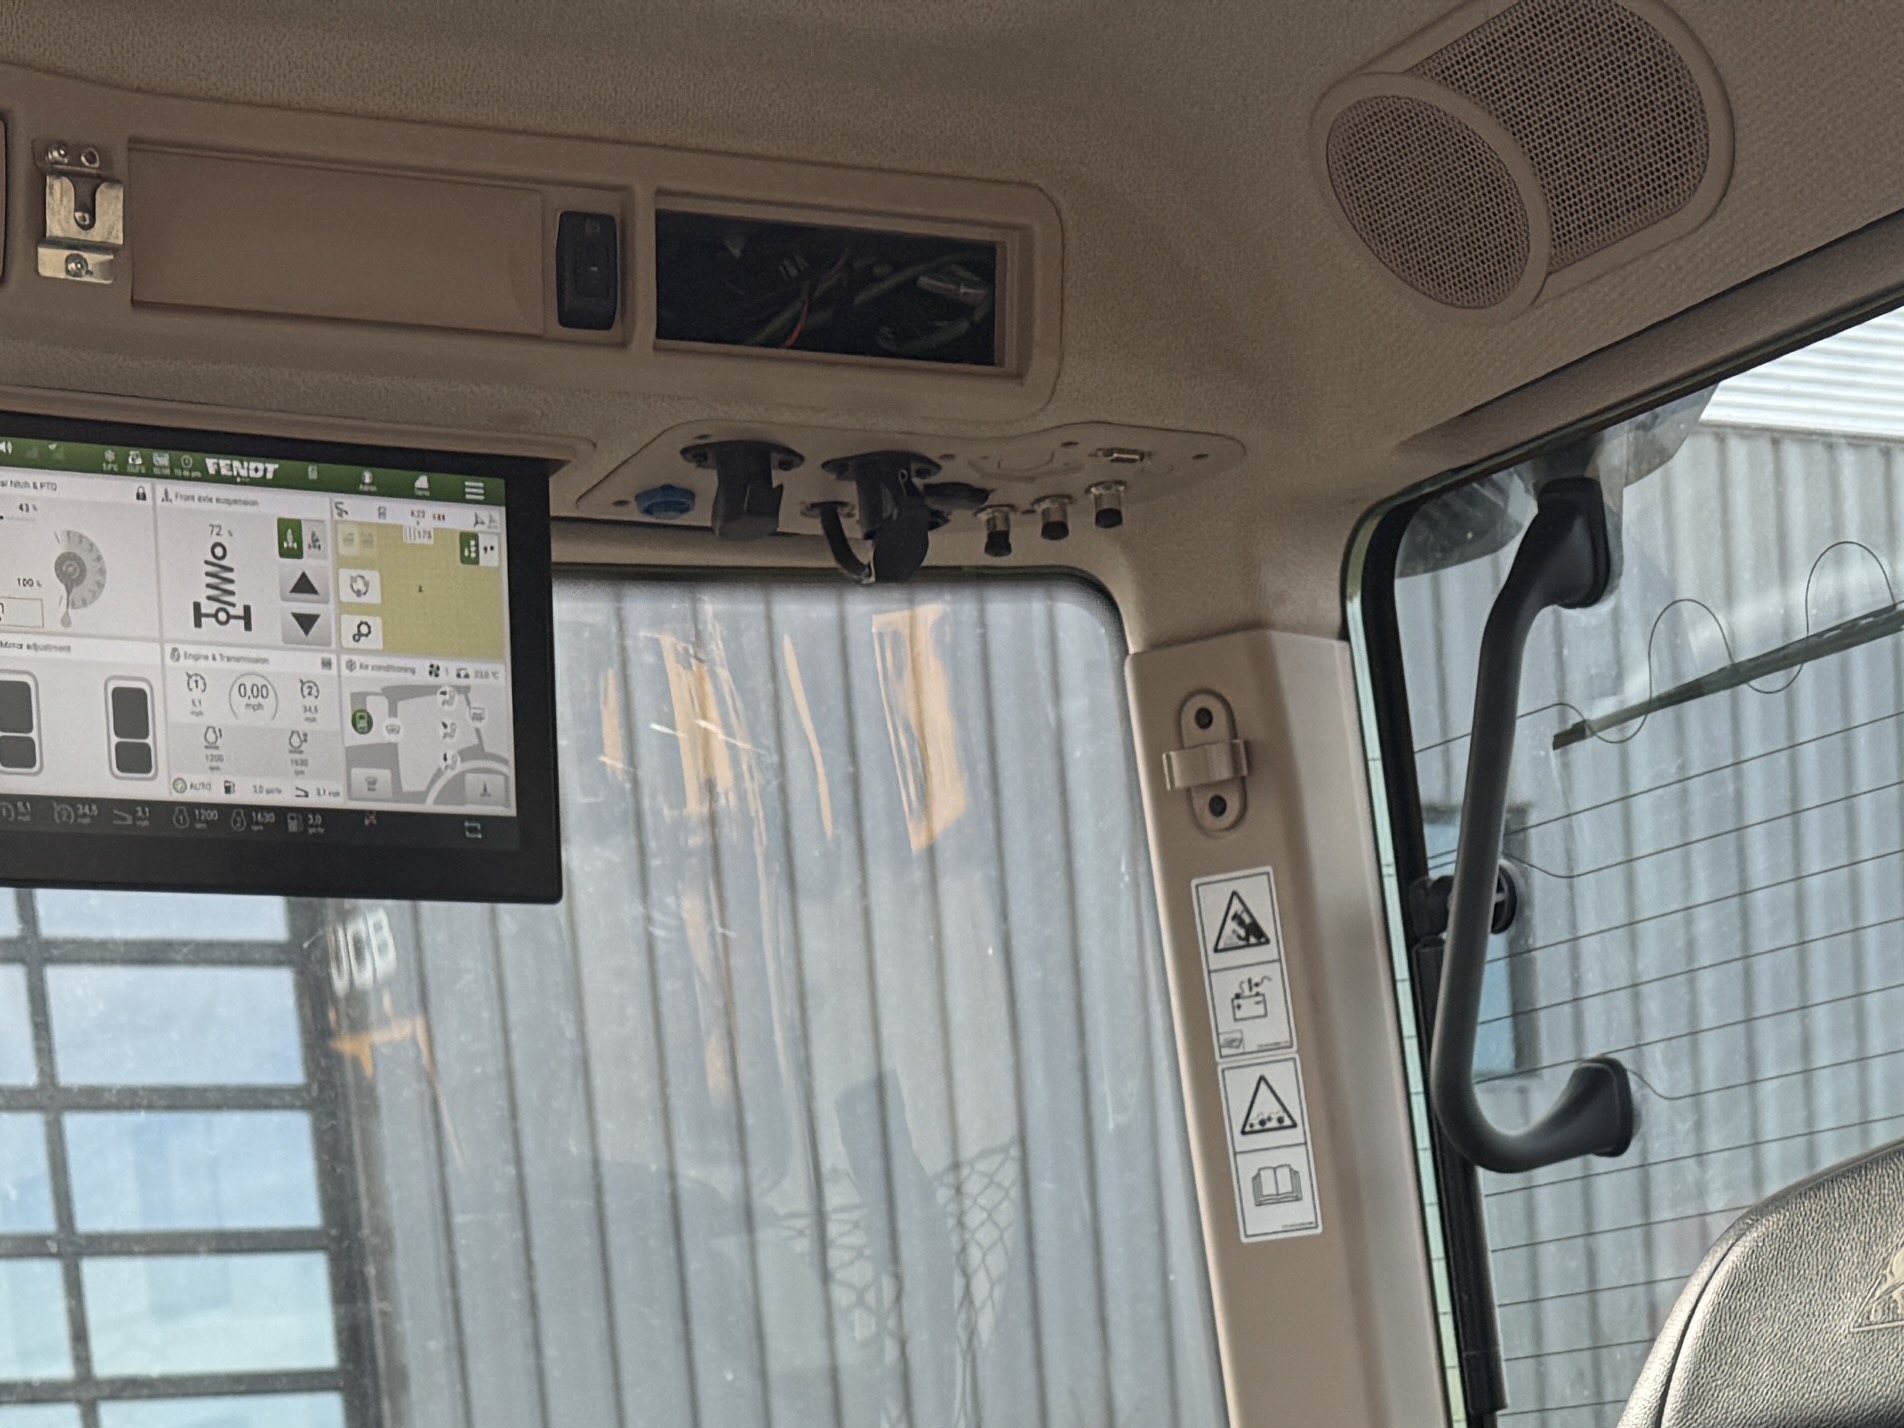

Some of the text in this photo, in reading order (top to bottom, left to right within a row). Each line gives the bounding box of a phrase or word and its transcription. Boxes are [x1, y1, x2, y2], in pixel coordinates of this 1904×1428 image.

[205, 457, 279, 479] FENDT
[175, 492, 196, 501] Front
[209, 524, 223, 536] 72
[17, 578, 34, 587] 100
[184, 652, 210, 662] Engine
[219, 654, 270, 665] Transmission
[238, 683, 269, 700] 0,00
[245, 703, 264, 712] mph
[190, 783, 211, 792] AUTO
[195, 809, 219, 820] 1200
